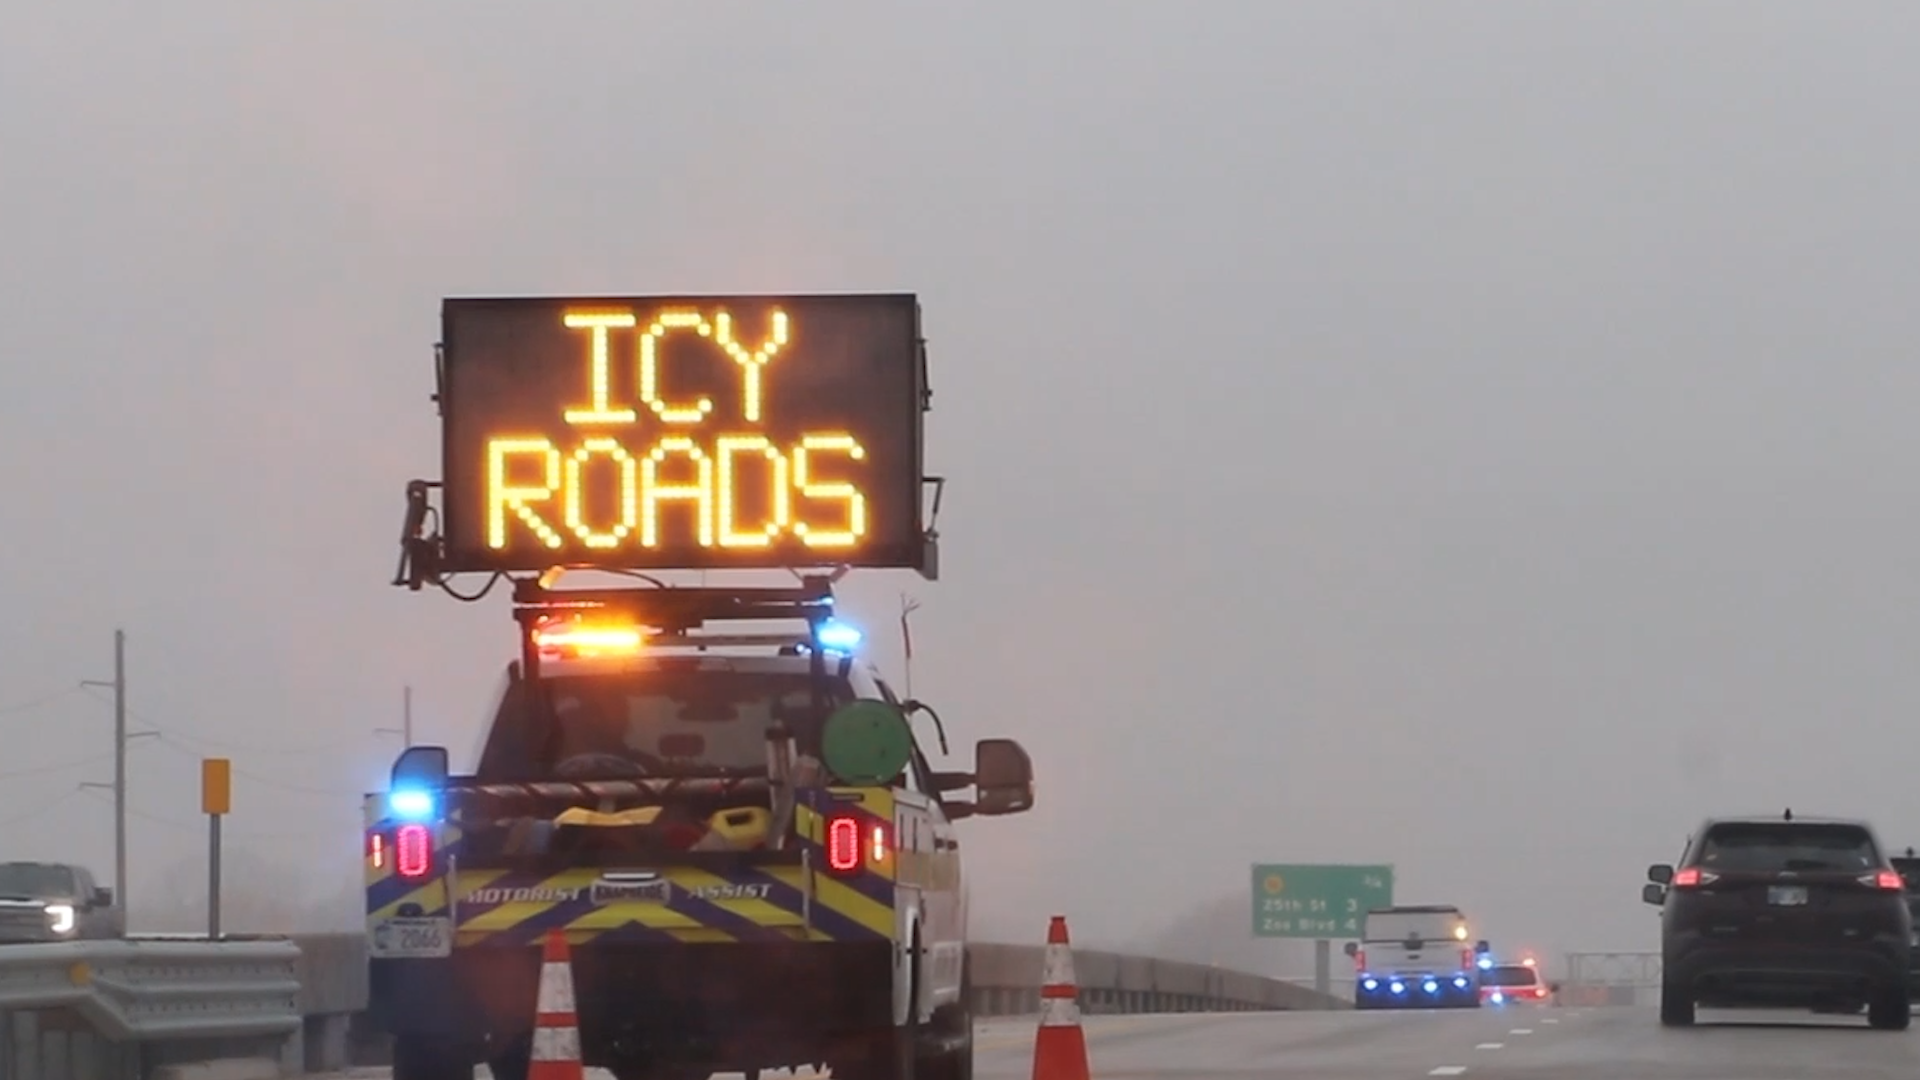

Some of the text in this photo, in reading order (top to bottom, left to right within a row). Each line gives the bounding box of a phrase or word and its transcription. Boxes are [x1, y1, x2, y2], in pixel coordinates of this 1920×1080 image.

[563, 311, 789, 425] ICY
[488, 435, 866, 549] ROADS
[467, 887, 581, 903] MOTORIST
[688, 883, 772, 899] ASSIST
[1263, 898, 1358, 913] 25th St 3
[1345, 918, 1357, 931] 4
